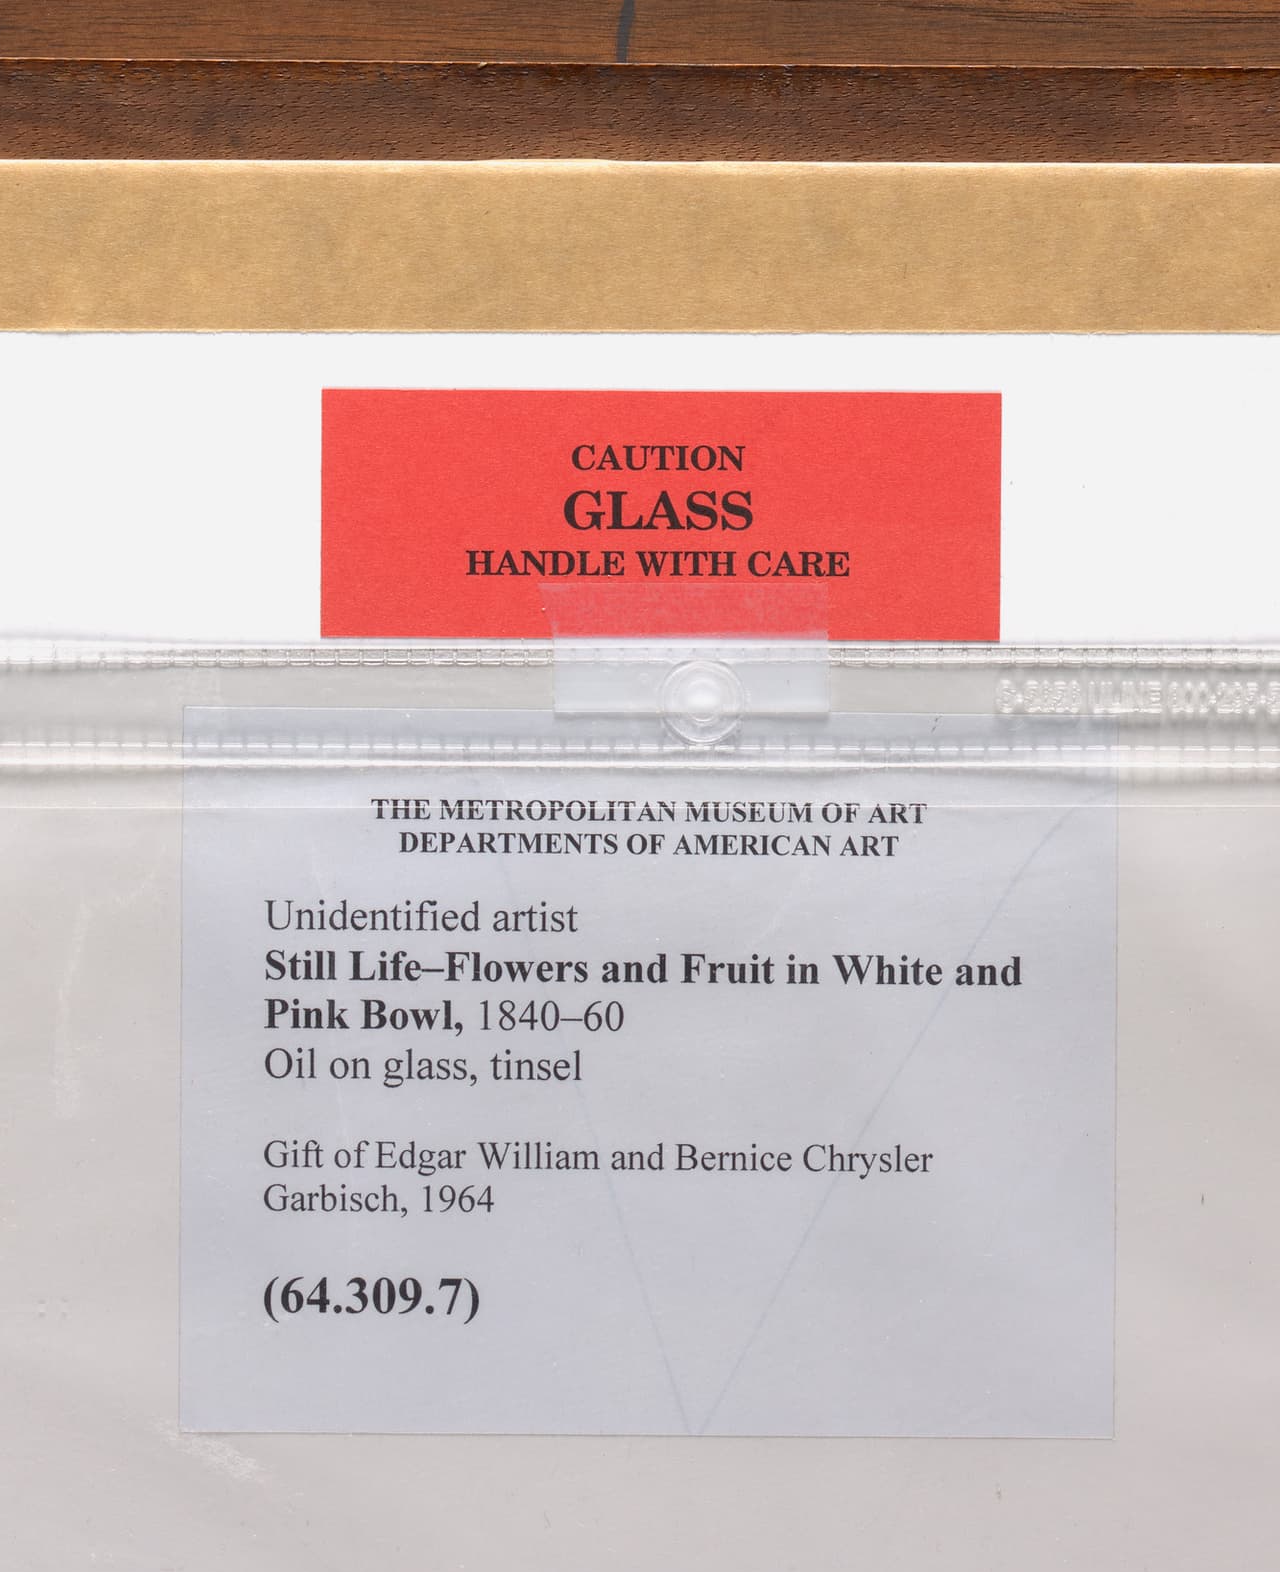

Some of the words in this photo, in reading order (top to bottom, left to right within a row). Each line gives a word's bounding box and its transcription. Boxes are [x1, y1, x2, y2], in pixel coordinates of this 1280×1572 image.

[571, 444, 746, 472] CAUTION
[563, 489, 754, 532] GLASS
[465, 549, 625, 577] HANDLE
[634, 550, 737, 577] WITH
[747, 550, 850, 578] CARE
[399, 831, 619, 855] DEPARTMENTS
[626, 833, 666, 856] OF
[672, 834, 832, 857] AMERICAN
[839, 835, 900, 857] ART
[265, 899, 481, 932] Unidentified
[492, 901, 579, 933] artist
[265, 949, 337, 981] Still
[601, 953, 669, 984] and
[680, 953, 775, 985] Fruit
[786, 953, 820, 985] in
[832, 954, 943, 986] White
[955, 955, 1023, 987] and
[263, 998, 350, 1030] Pink
[360, 999, 464, 1037] Bowl,
[264, 1047, 317, 1079] Oil
[329, 1057, 372, 1080] on
[383, 1048, 478, 1089] glass,
[489, 1048, 582, 1082] tinsel
[263, 1139, 324, 1169] Gift
[334, 1139, 370, 1169] of
[375, 1140, 467, 1177] Edgar
[477, 1141, 601, 1171] William
[610, 1142, 665, 1171] and
[674, 1143, 793, 1172] Bernice
[802, 1143, 934, 1180] Chrysler
[263, 1183, 408, 1218] Garbisch,
[423, 1184, 495, 1213] 1964
[263, 1276, 480, 1325] (64.309.7)
